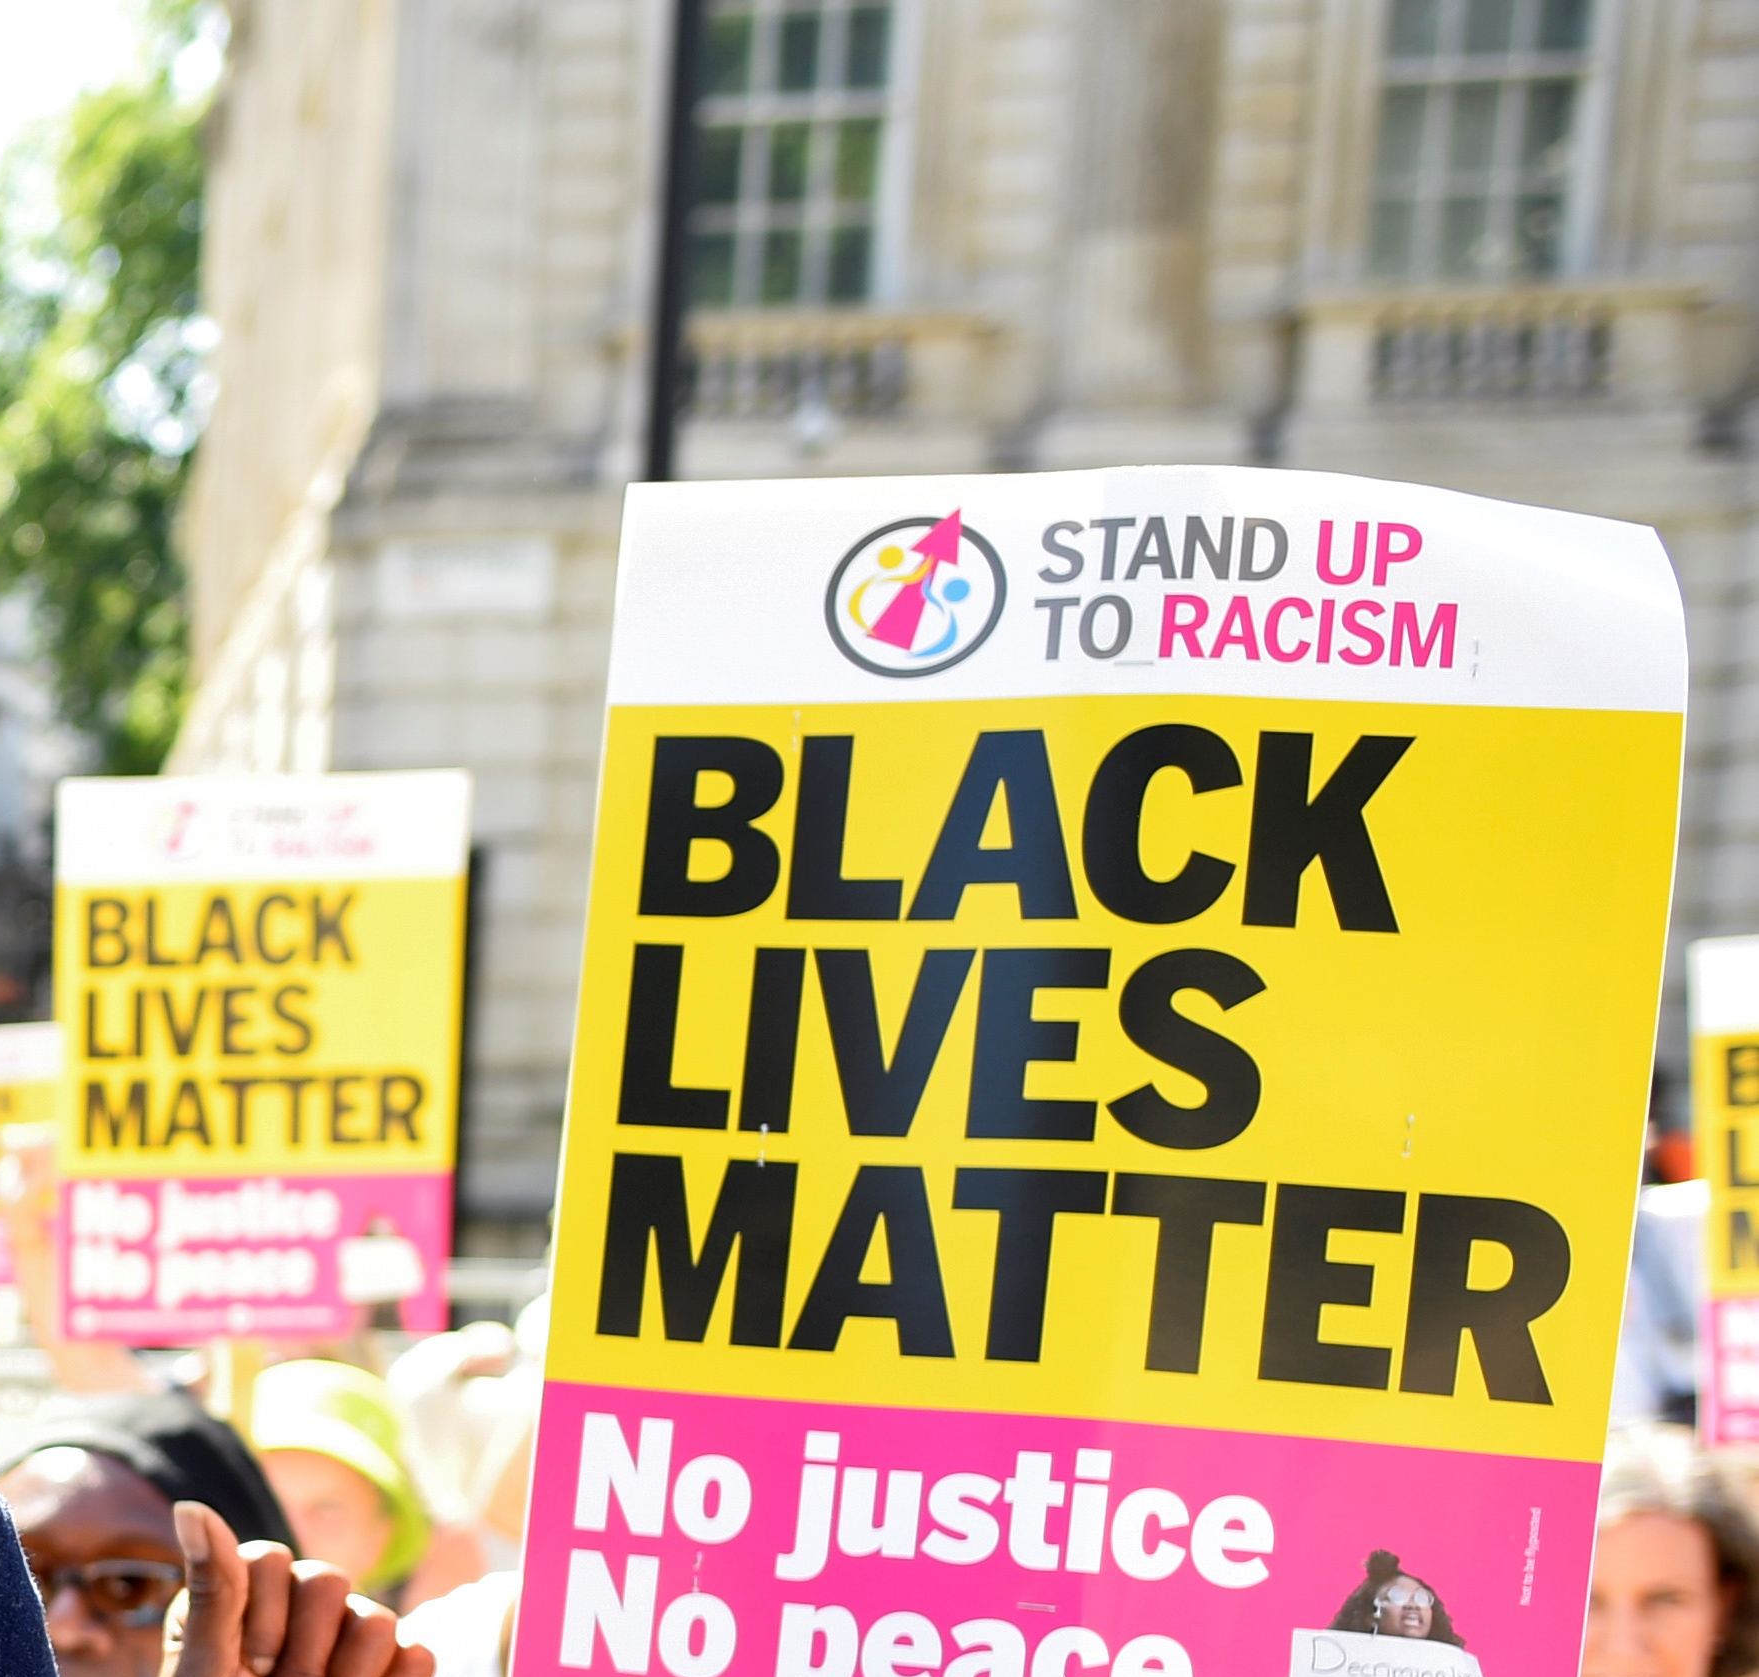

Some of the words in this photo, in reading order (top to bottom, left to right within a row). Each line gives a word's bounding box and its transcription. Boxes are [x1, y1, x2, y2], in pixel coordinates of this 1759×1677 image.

[1036, 515, 1290, 585] STAND
[1315, 519, 1423, 587] UP
[1034, 594, 1134, 661] TO
[1158, 593, 1459, 669] RACISM
[638, 723, 1416, 934] BLACK
[86, 892, 356, 969] BLACK
[85, 983, 315, 1060] LIVES
[617, 943, 1267, 1150] LIVES
[83, 1072, 428, 1149] MATTER
[72, 1182, 153, 1242] No
[157, 1178, 342, 1248] justice
[71, 1242, 152, 1300] No
[157, 1247, 317, 1308] peace
[596, 1152, 1571, 1406] MATTER
[573, 1412, 752, 1544] No
[775, 1430, 1275, 1589] justice
